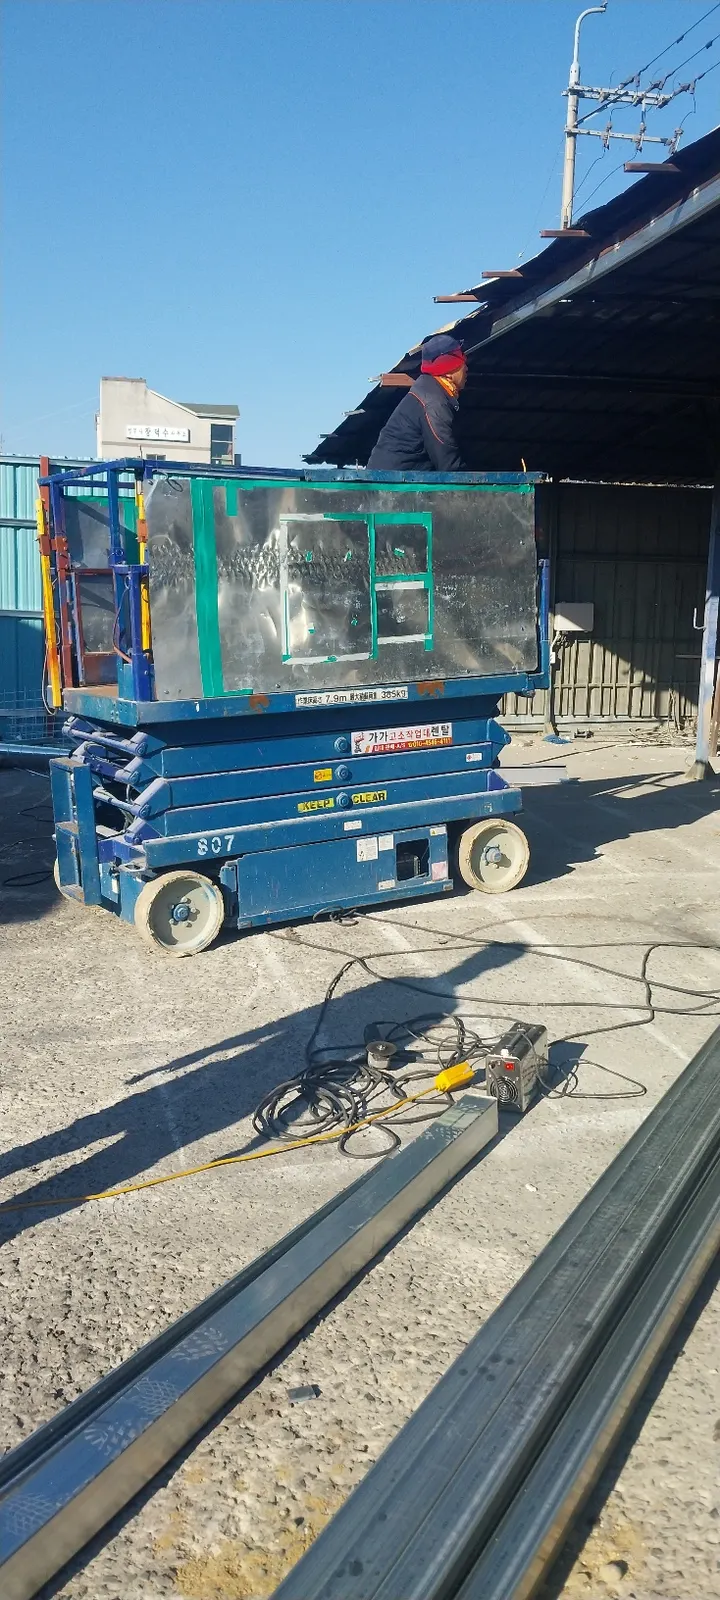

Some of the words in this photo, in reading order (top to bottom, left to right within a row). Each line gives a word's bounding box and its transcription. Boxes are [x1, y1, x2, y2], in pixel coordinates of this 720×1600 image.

[325, 694, 347, 703] 7.9m
[302, 799, 330, 811] KEEP
[353, 792, 386, 804] CLEAR
[197, 834, 235, 856] 807
